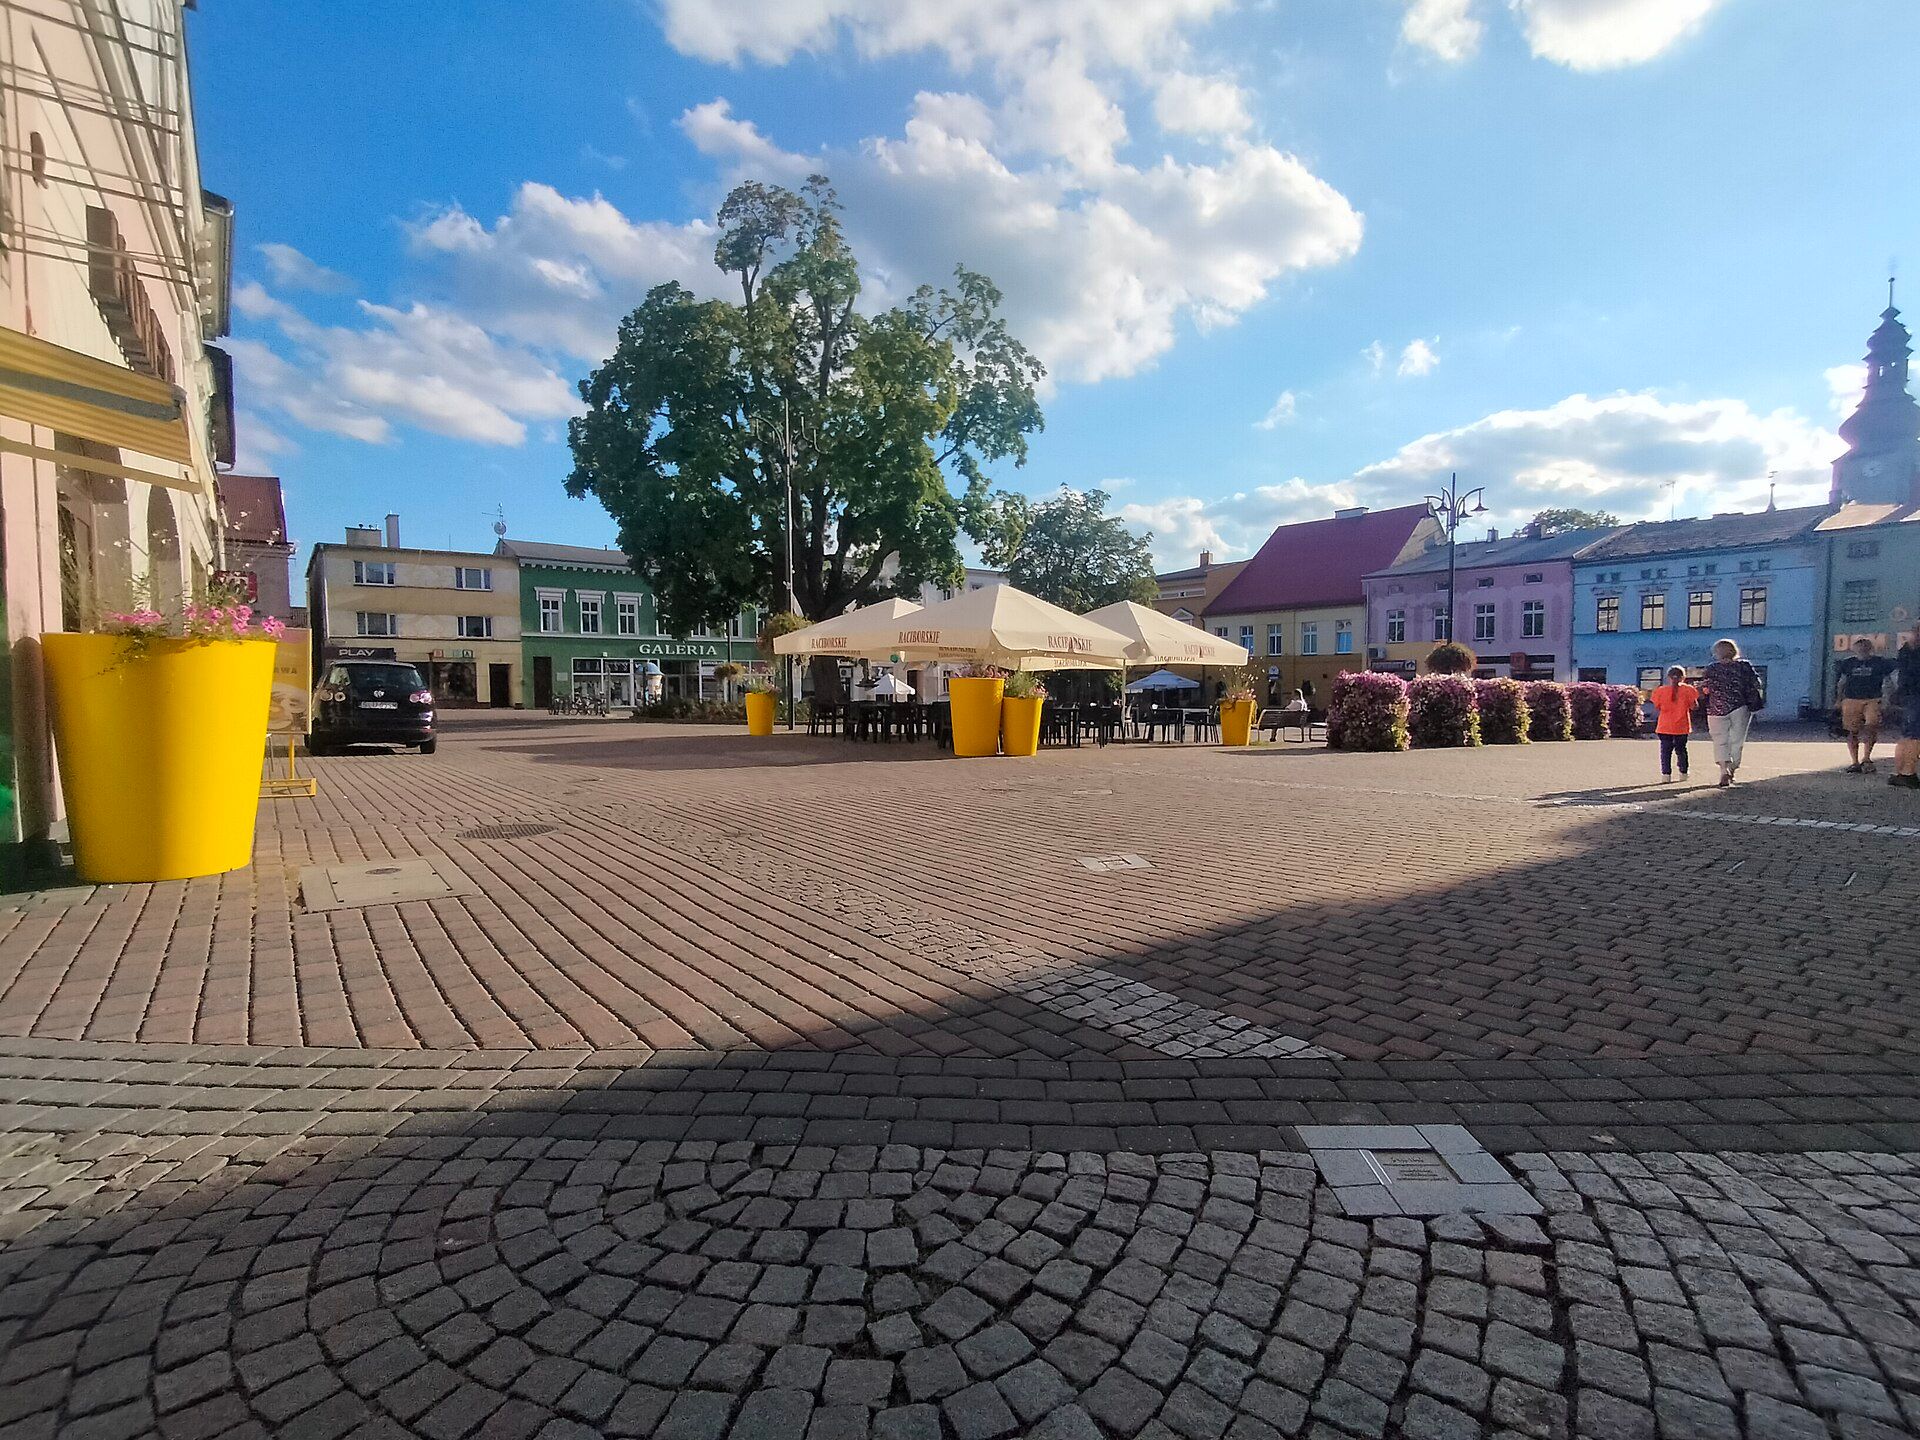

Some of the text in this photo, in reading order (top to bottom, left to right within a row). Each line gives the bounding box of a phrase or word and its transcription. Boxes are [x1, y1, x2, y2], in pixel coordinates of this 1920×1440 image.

[811, 637, 848, 649] RACIBORSKIE
[898, 630, 941, 645] RACIBORSKIE
[639, 643, 717, 655] GALERIA
